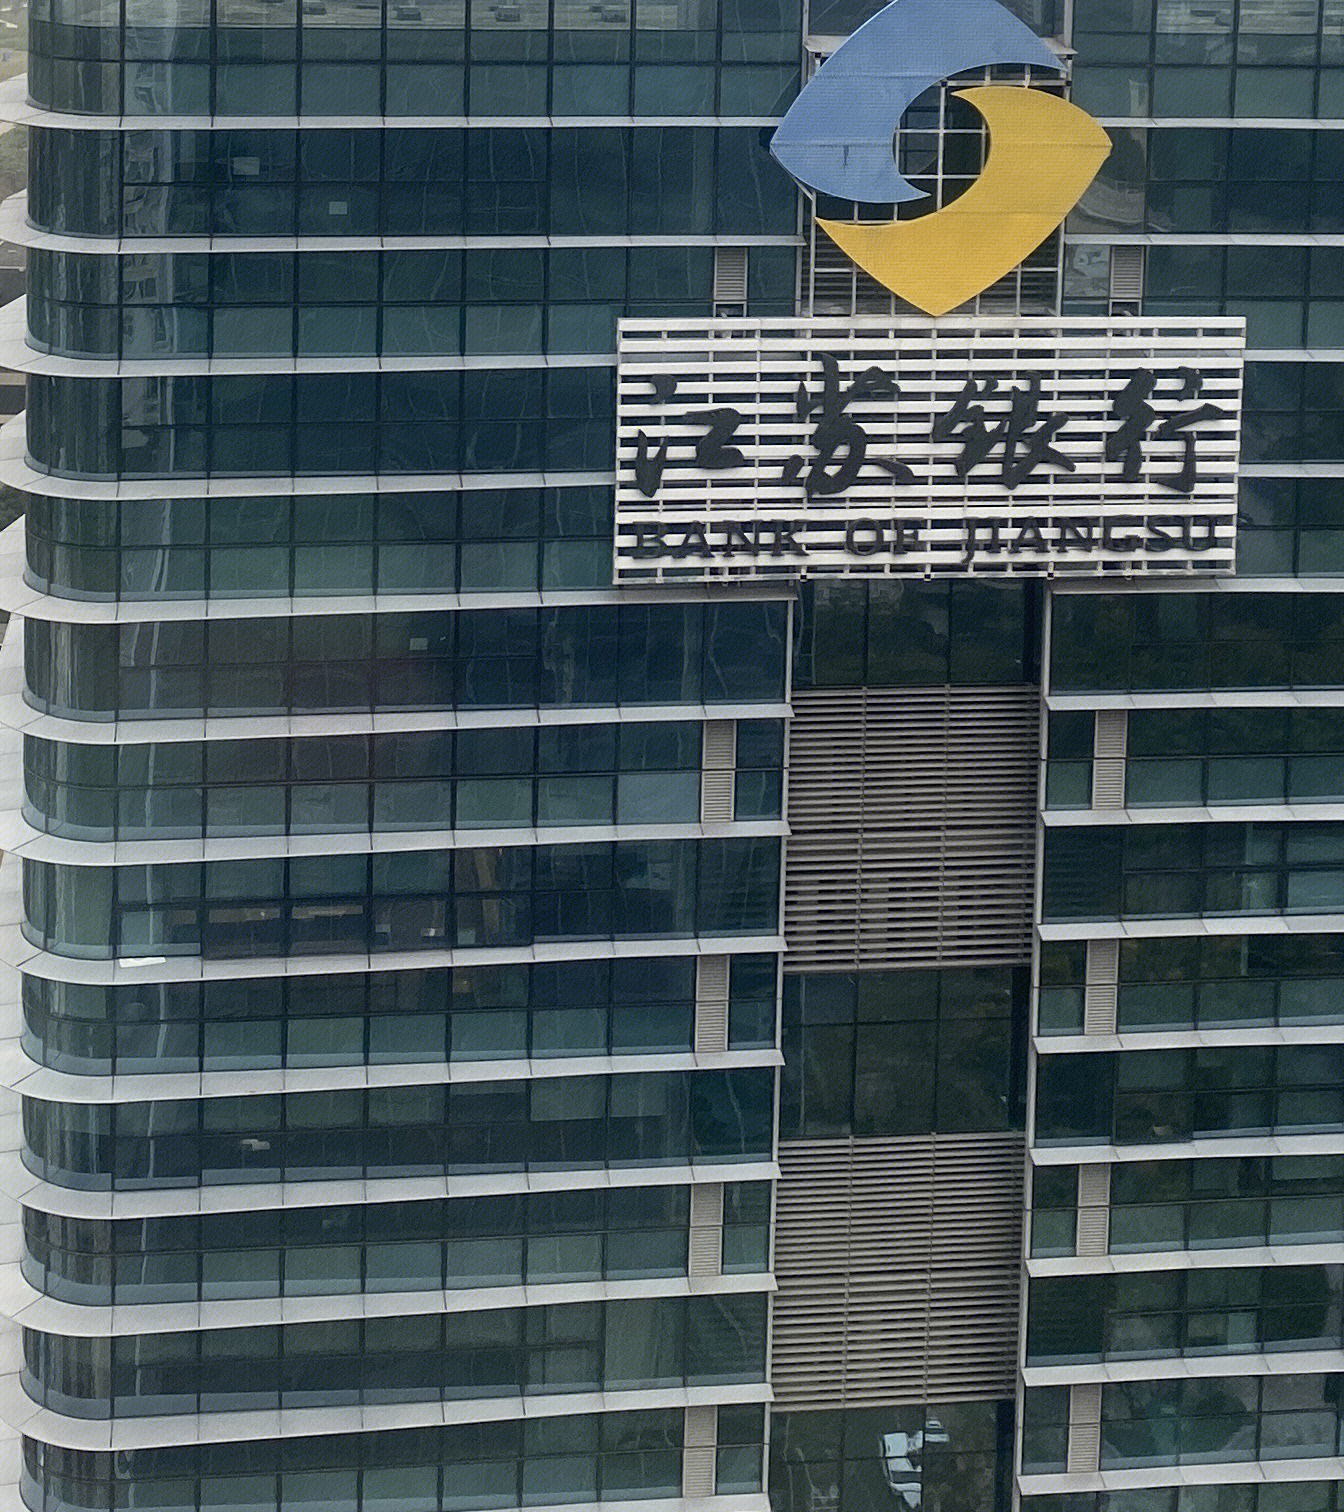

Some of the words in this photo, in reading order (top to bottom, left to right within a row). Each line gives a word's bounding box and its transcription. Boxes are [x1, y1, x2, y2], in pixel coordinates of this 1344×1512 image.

[634, 352, 1224, 499] 江苏银行
[632, 519, 809, 559] BANK
[845, 517, 925, 557] OF
[960, 514, 1218, 563] JIANGSU
